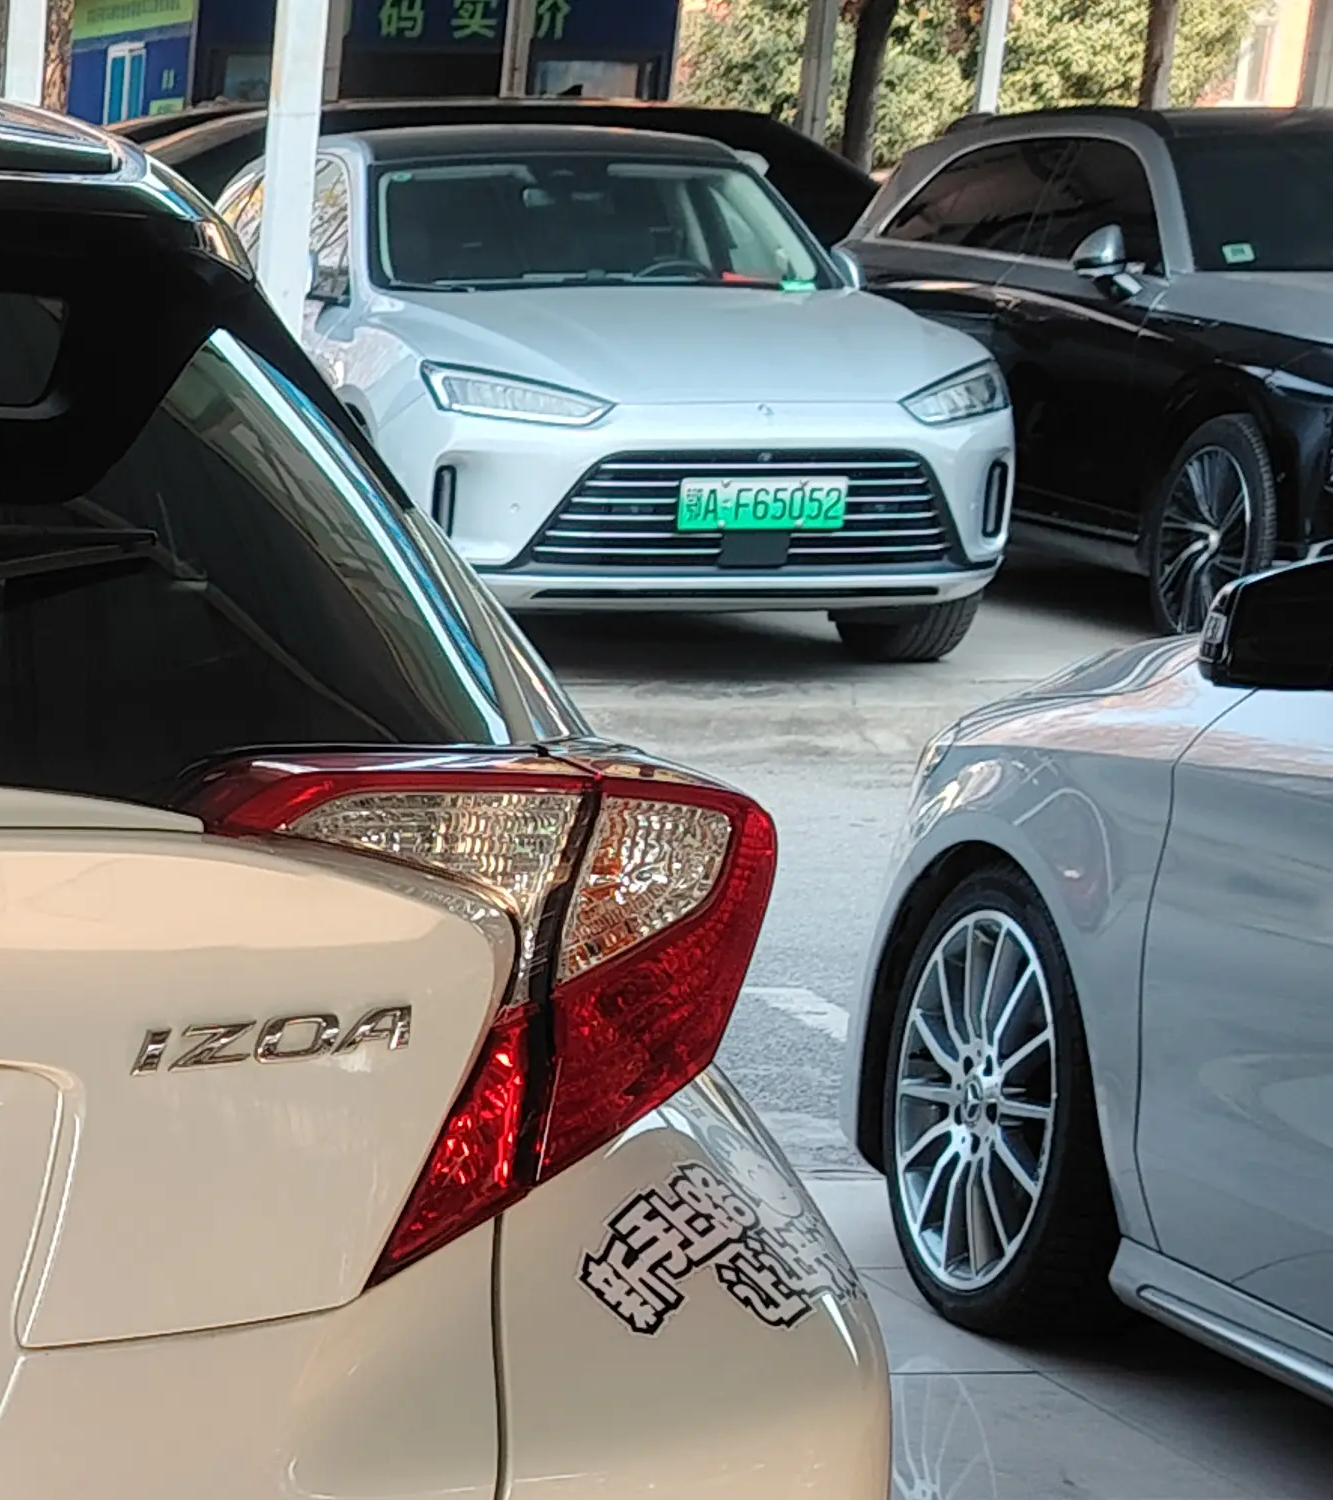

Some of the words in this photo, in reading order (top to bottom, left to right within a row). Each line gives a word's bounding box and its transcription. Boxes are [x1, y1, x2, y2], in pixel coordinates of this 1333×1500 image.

[343, 0, 572, 40] 码实价
[130, 1003, 413, 1078] IZOA
[579, 1162, 760, 1336] 新手上路
